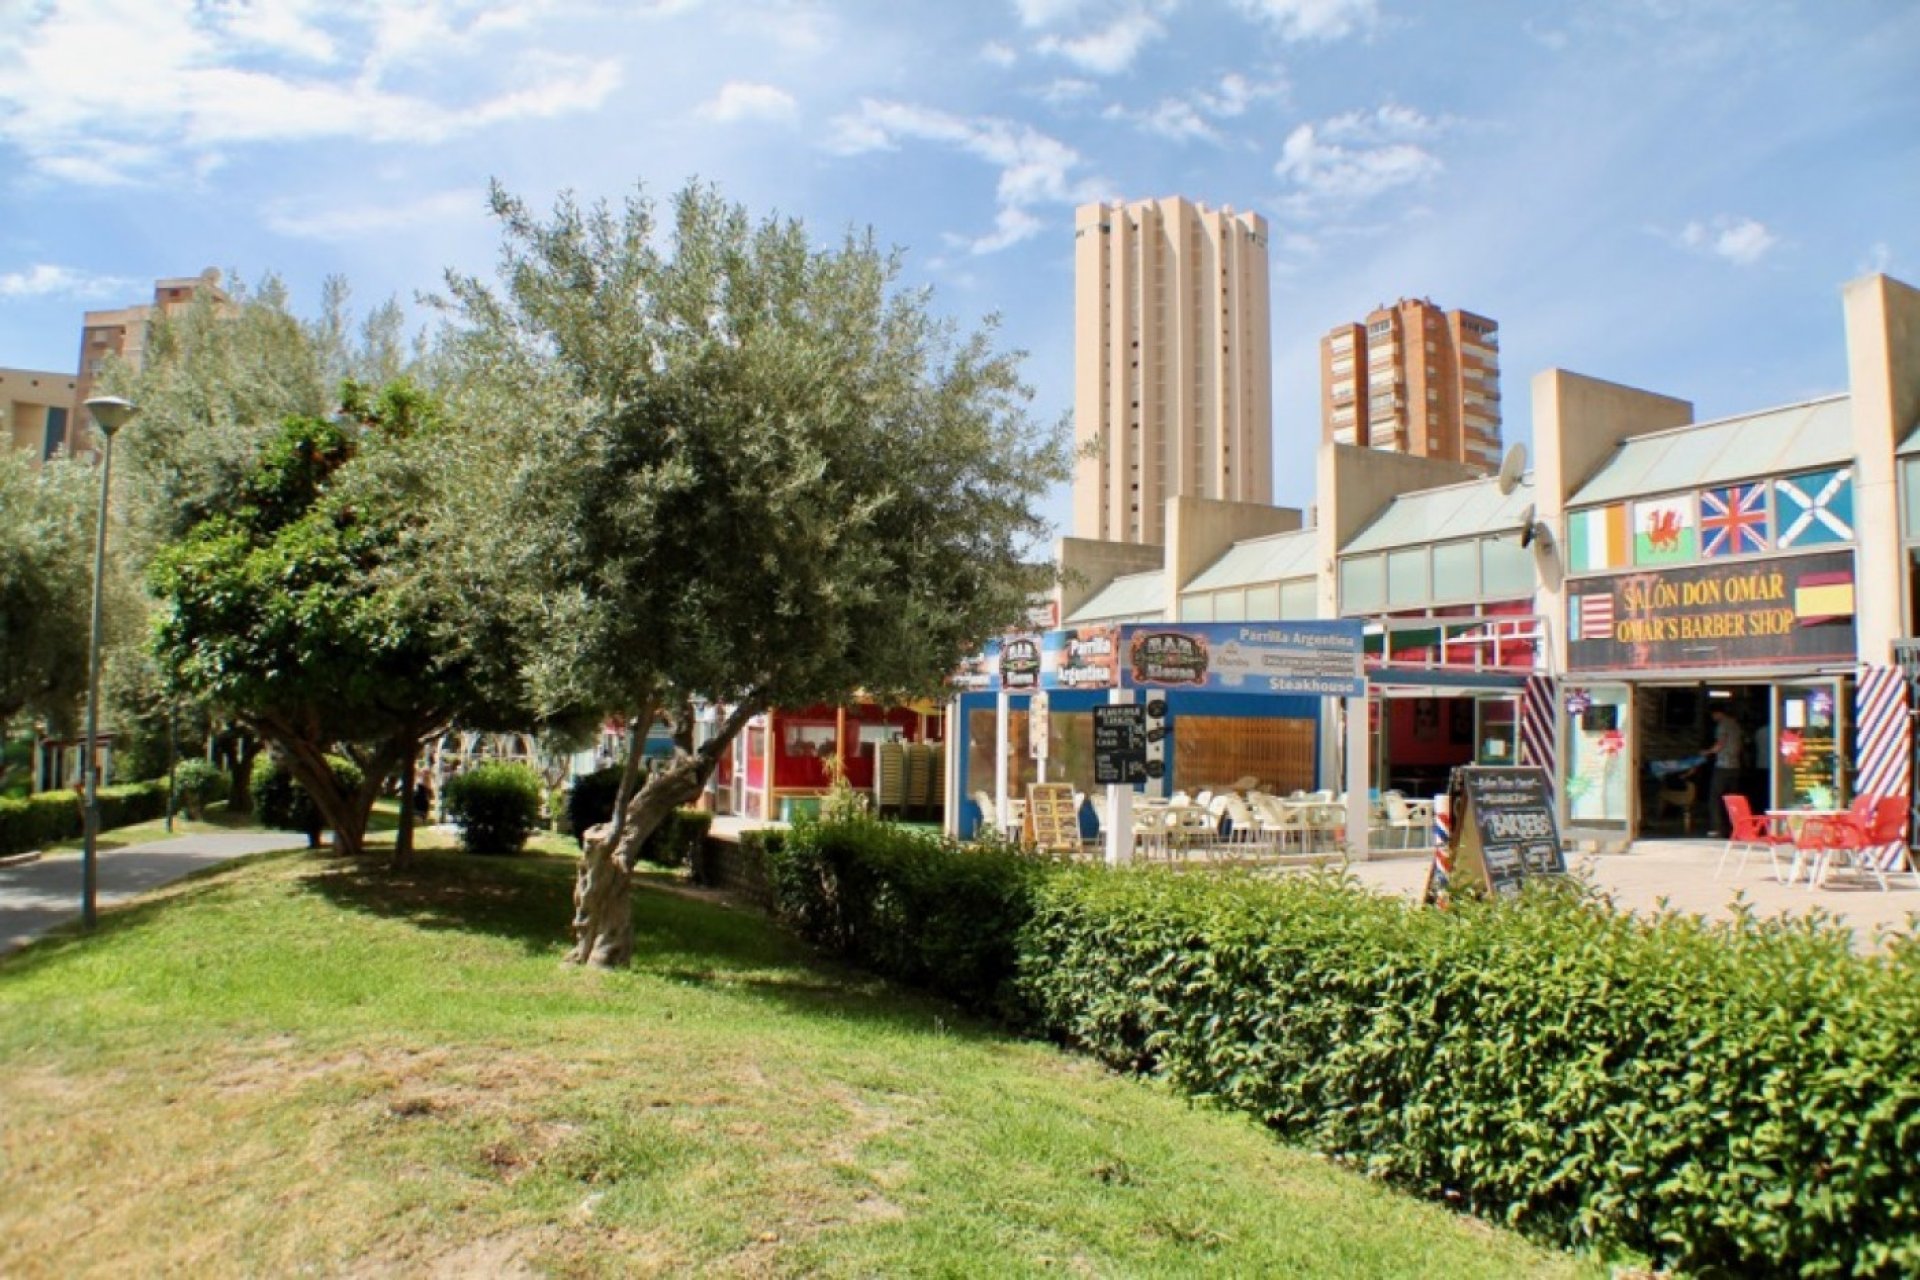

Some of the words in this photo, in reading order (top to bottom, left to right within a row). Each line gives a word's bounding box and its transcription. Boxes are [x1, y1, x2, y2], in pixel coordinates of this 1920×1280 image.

[1683, 577, 1720, 606] DON
[1617, 617, 1679, 642] OMAR'S
[1681, 612, 1746, 639] BARBER
[1750, 608, 1794, 635] SHOP
[1240, 628, 1288, 643] Parrilla
[1293, 632, 1354, 647] Argentina
[1058, 666, 1111, 685] Argentina
[1269, 677, 1354, 693] Steakhouse
